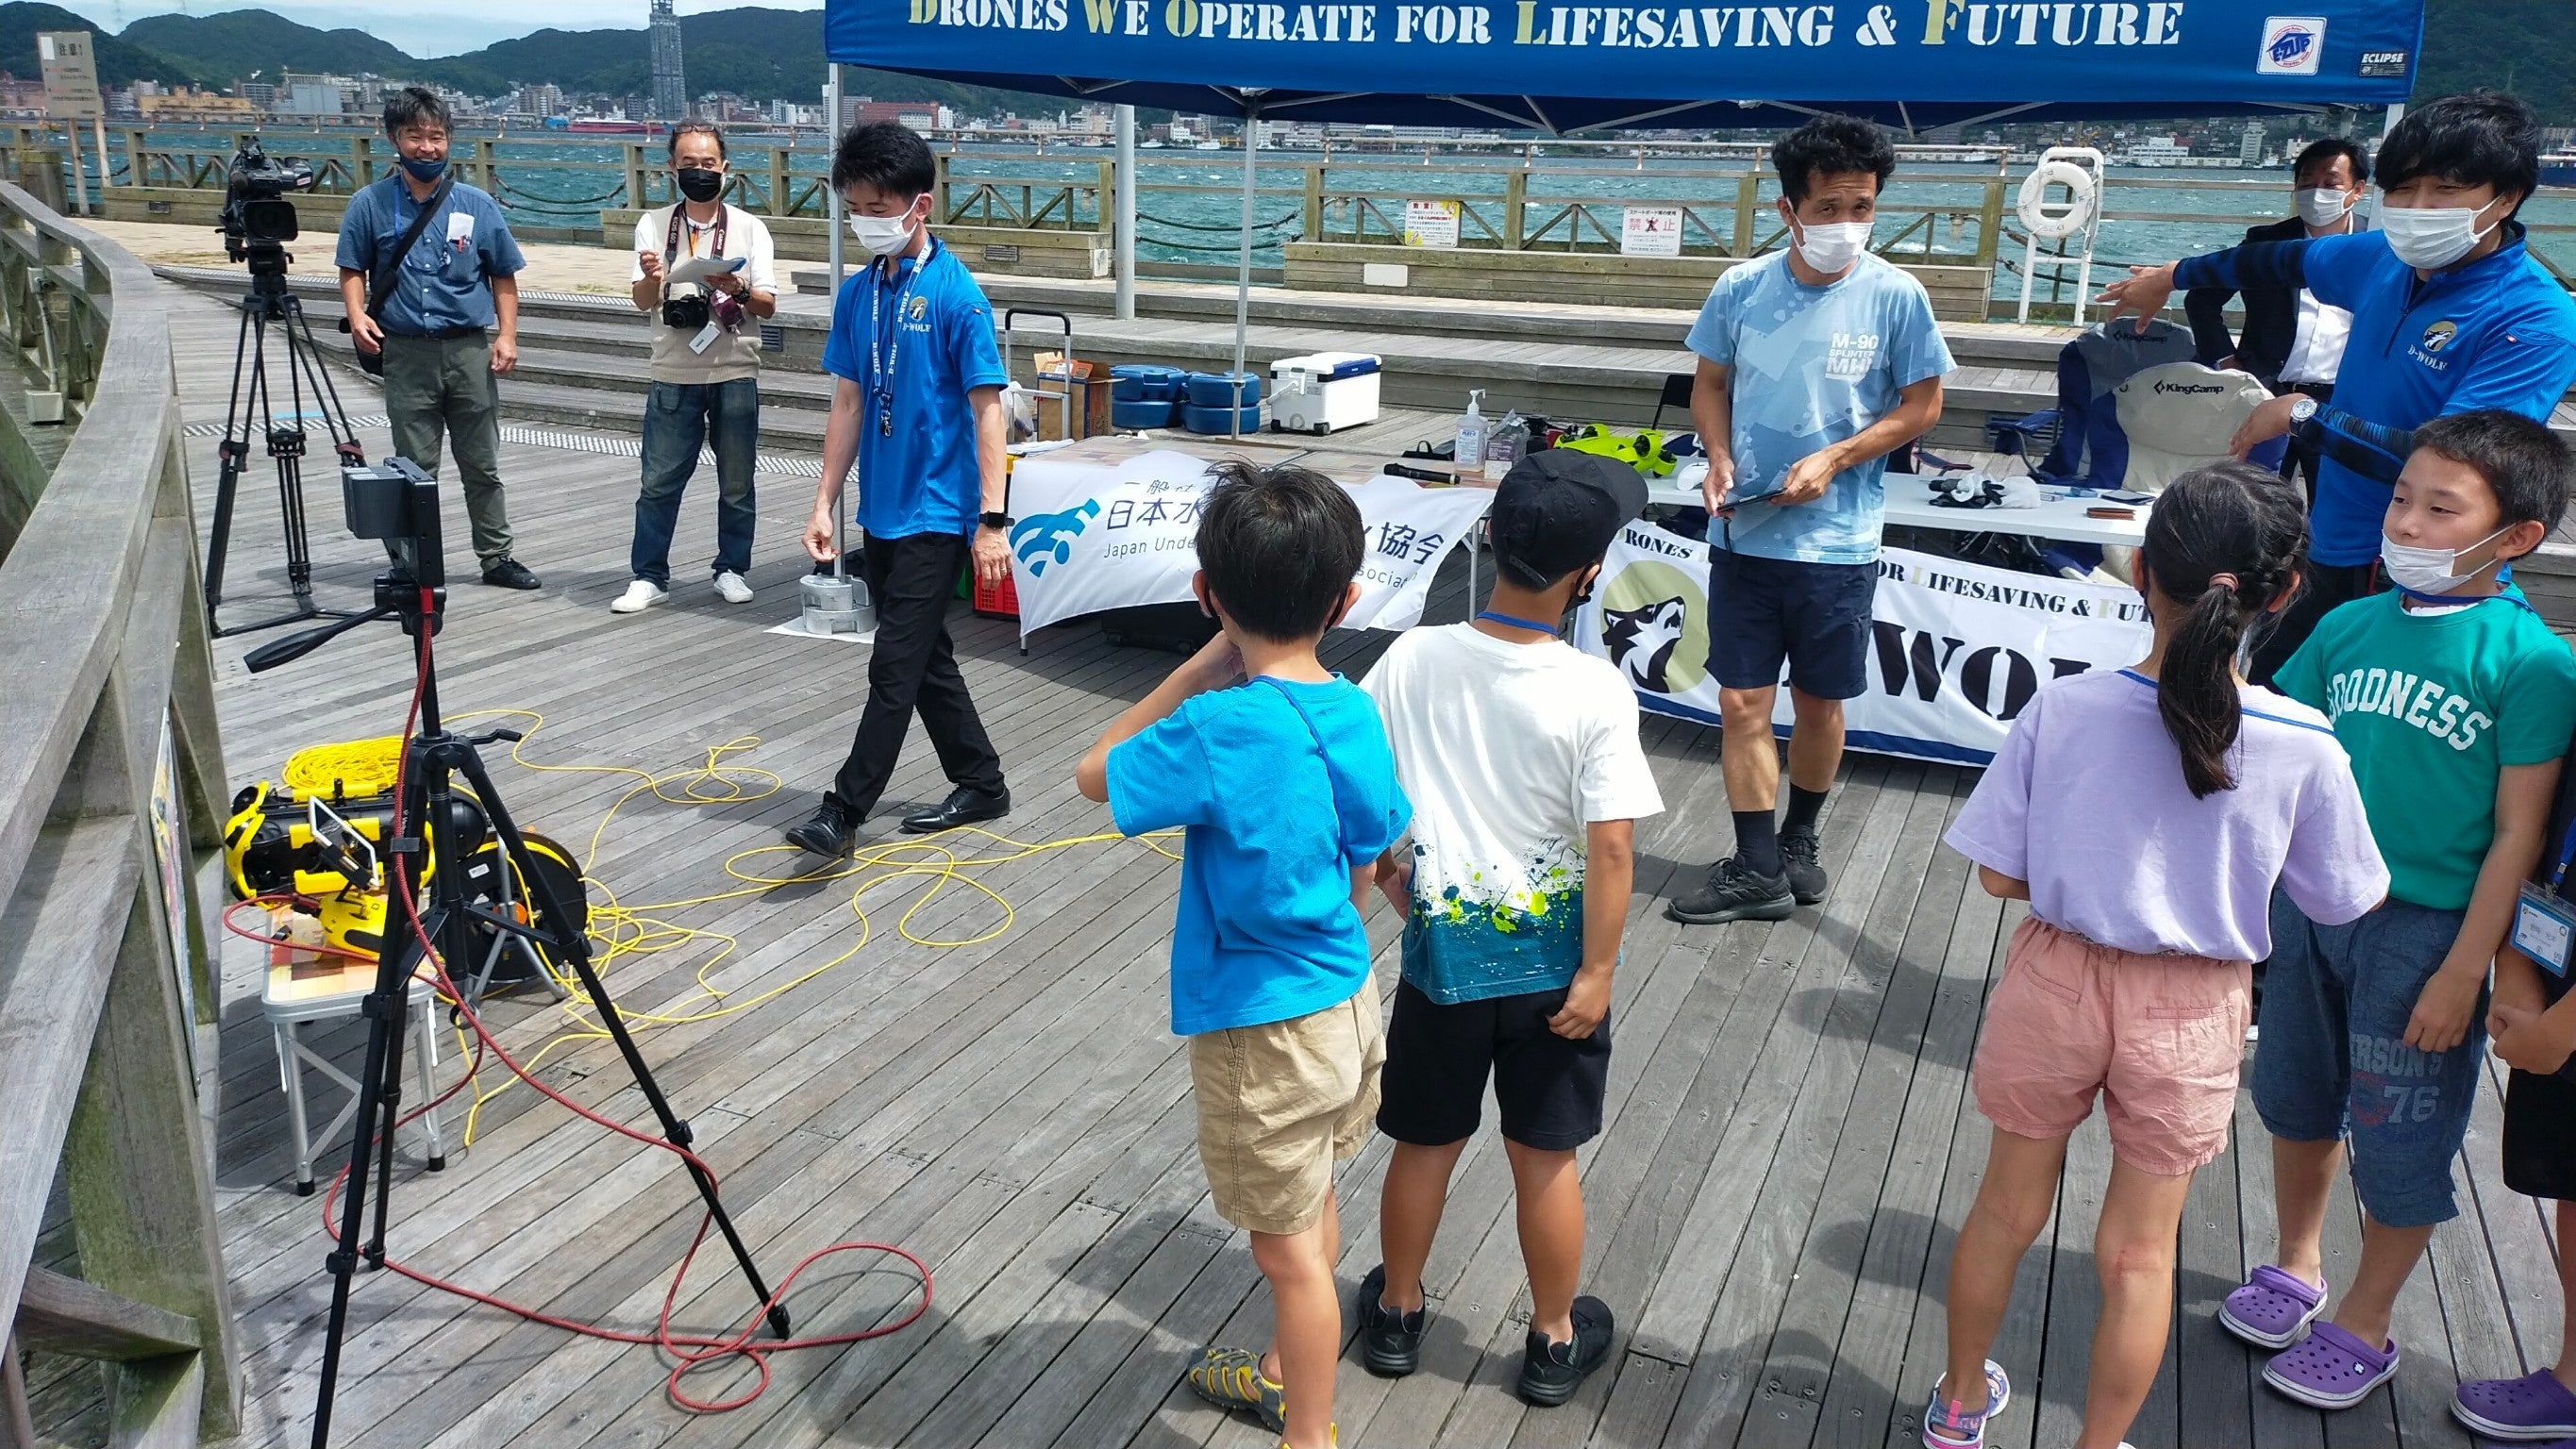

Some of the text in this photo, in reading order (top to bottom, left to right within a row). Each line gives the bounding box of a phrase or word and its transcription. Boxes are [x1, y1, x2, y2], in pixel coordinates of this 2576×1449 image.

[908, 0, 2183, 48] DRONES WE OPERATE FOR LIFESAVING & FUTURE
[2361, 53, 2404, 63] ECLIPSE
[1831, 332, 1880, 350] M-90
[2407, 343, 2448, 371] D-WOLF
[2166, 383, 2224, 394] KingCamp
[1103, 542, 1147, 559] Japan
[1154, 536, 1196, 552] Unde
[1910, 567, 2066, 613] LIFESAVING
[2071, 598, 2090, 617] &
[2384, 1084, 2440, 1124] 76
